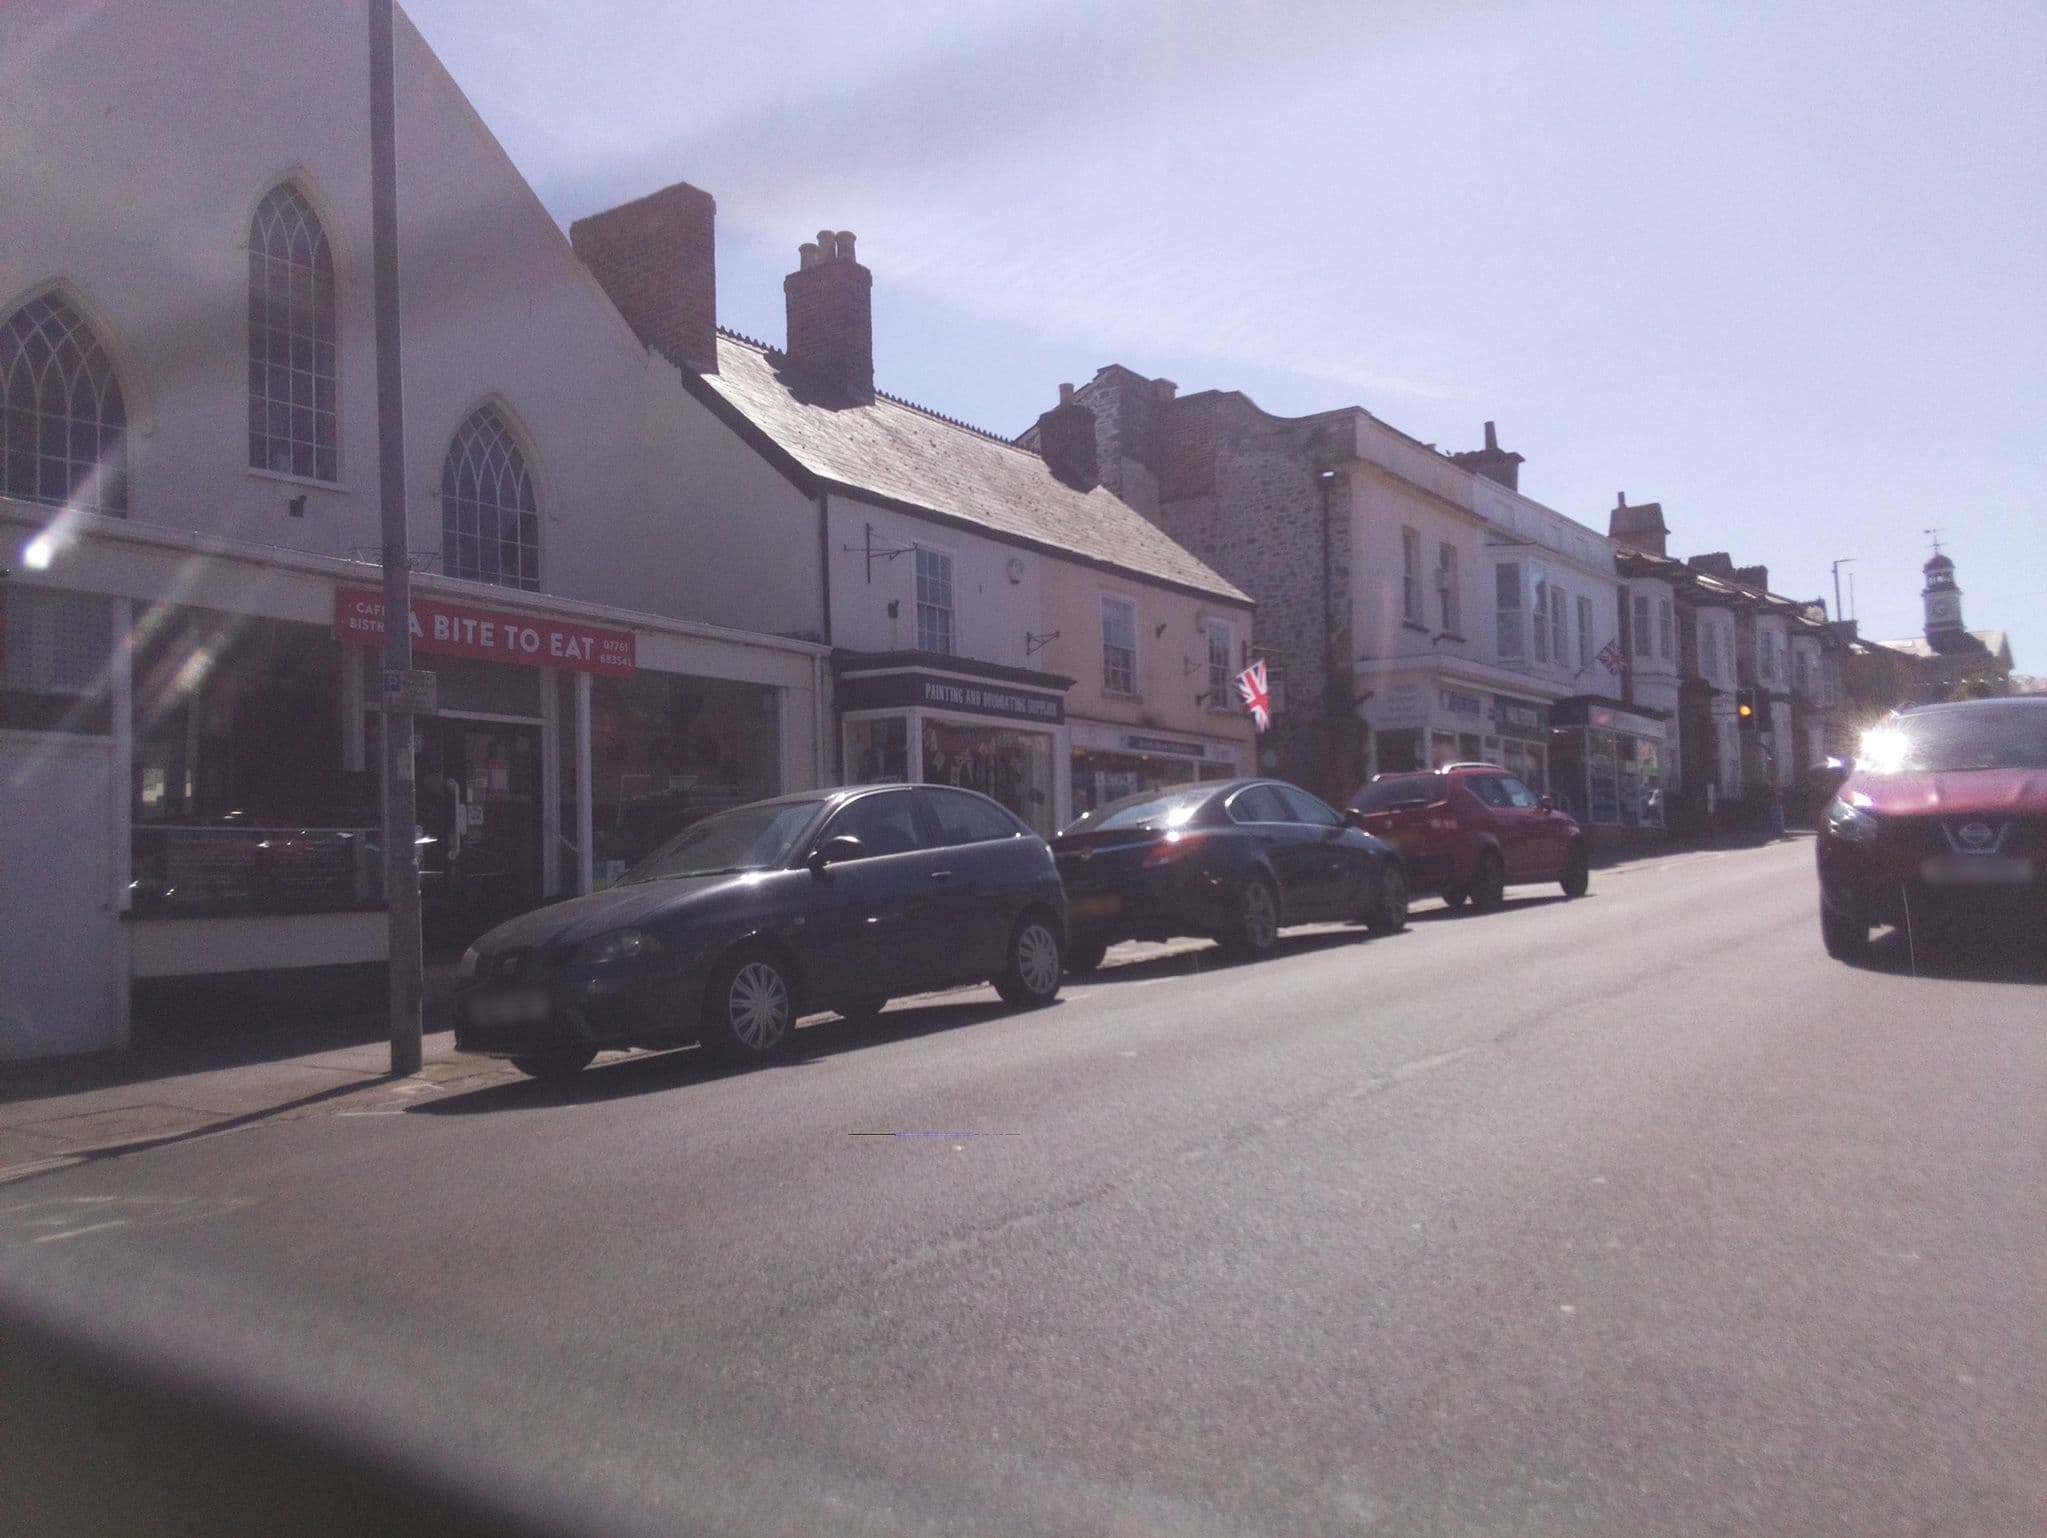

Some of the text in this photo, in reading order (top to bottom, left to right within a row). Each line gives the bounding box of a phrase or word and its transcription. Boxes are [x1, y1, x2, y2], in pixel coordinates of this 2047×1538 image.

[349, 617, 385, 633] BISTR
[408, 611, 594, 661] A BITE TO EAT
[925, 682, 964, 704] PAINTING
[965, 688, 981, 706] AND
